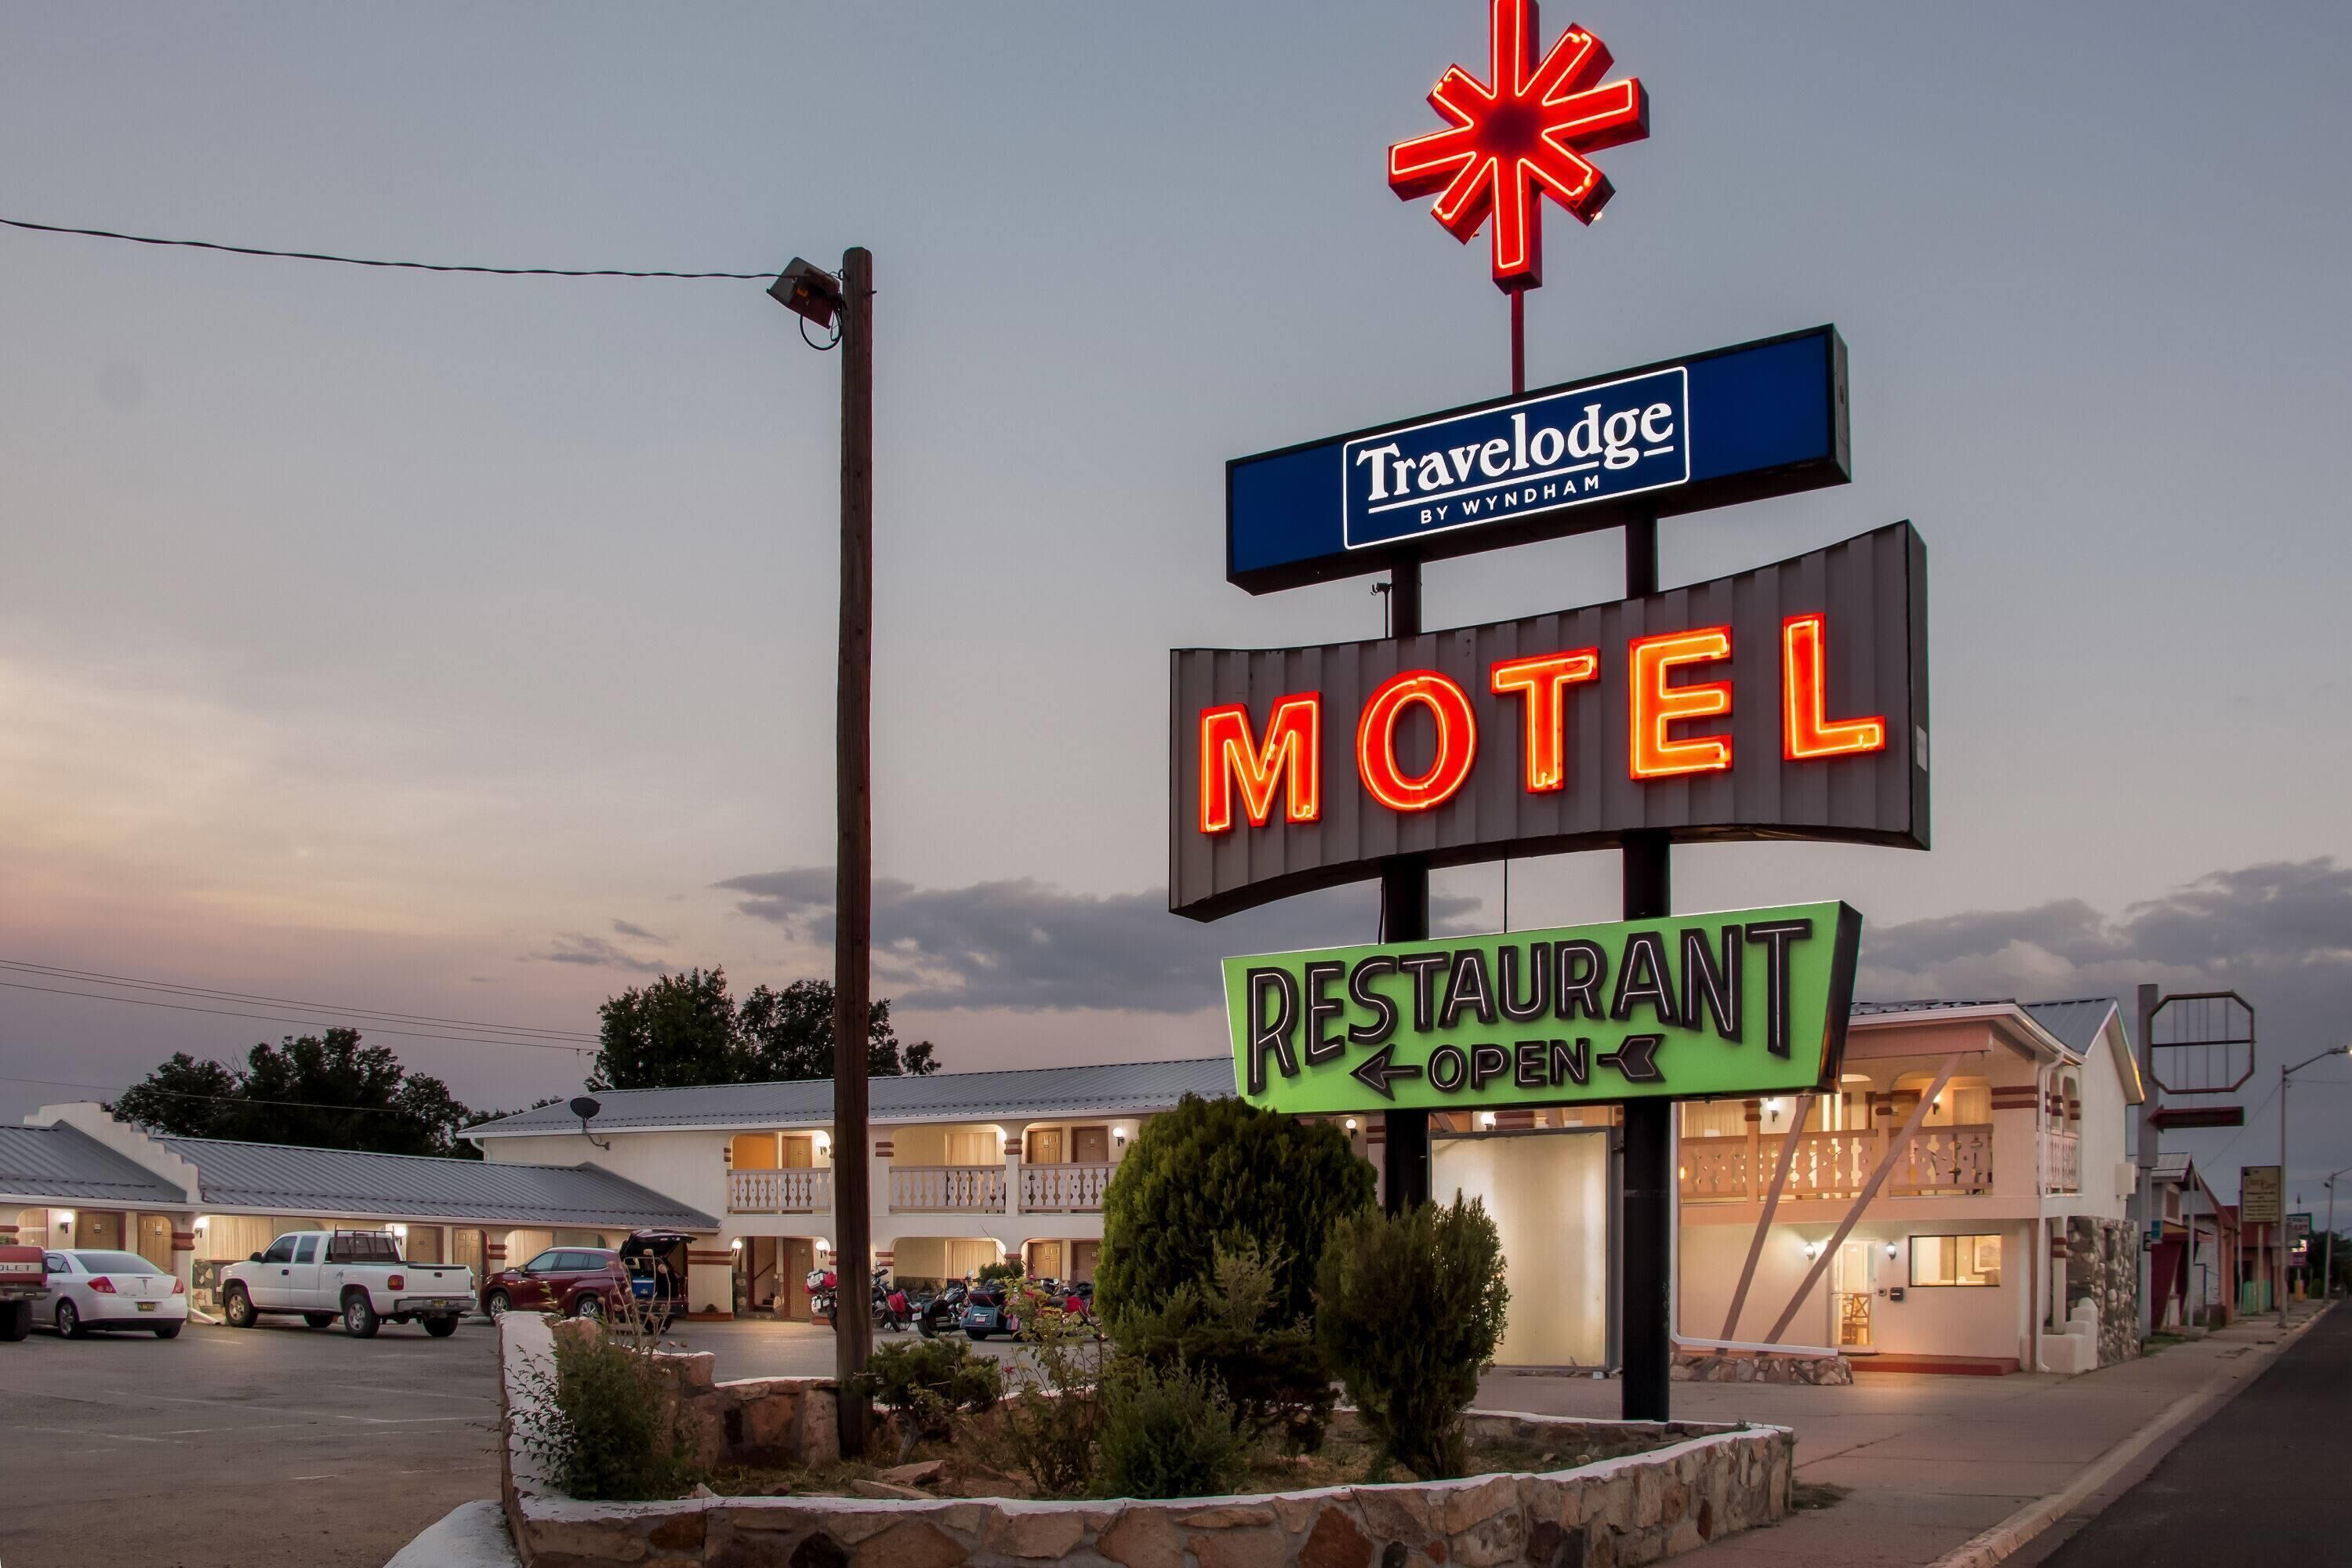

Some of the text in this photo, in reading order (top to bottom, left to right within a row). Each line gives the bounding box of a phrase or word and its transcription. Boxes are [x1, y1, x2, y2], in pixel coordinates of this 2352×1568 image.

[1356, 402, 1675, 502] Travelodge
[1421, 474, 1600, 524] BY WYNDHAM
[1199, 612, 1886, 834] MOTEL
[1246, 917, 1813, 1097] RESTAURANT
[1428, 1037, 1591, 1091] OPEN
